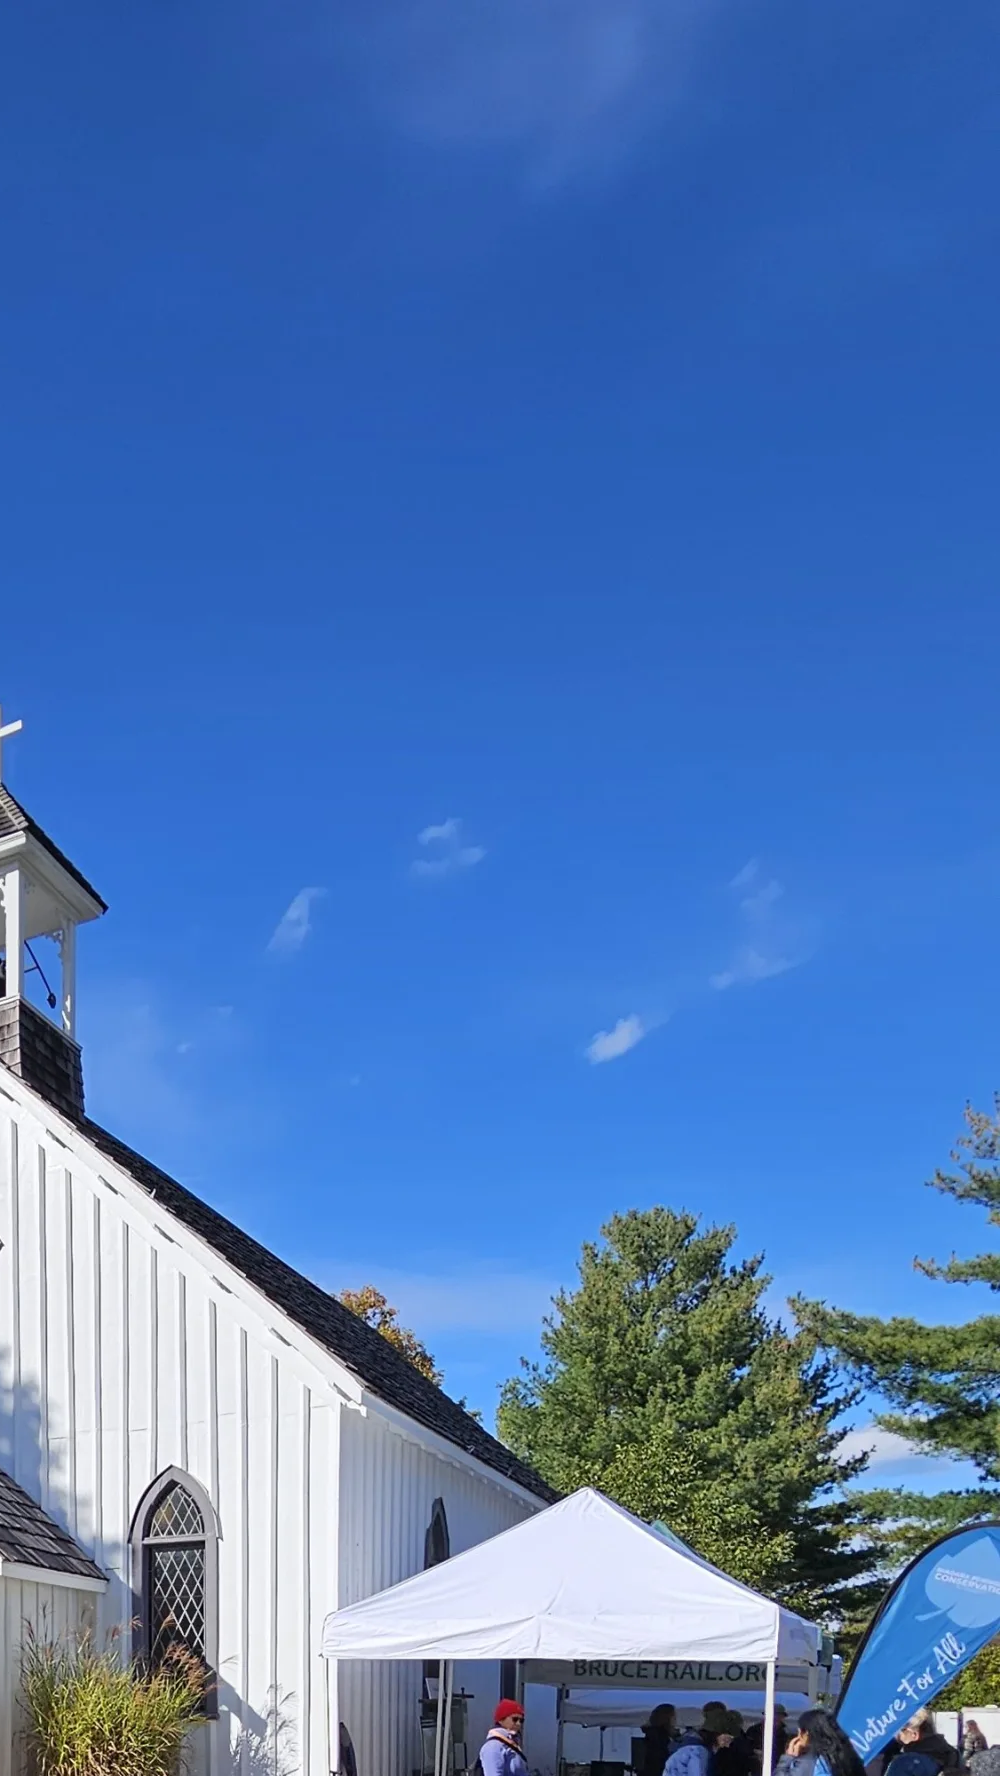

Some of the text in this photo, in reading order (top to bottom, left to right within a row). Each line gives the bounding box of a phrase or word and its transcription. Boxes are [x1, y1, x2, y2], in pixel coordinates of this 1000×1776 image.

[850, 1632, 966, 1759] Nature For All
